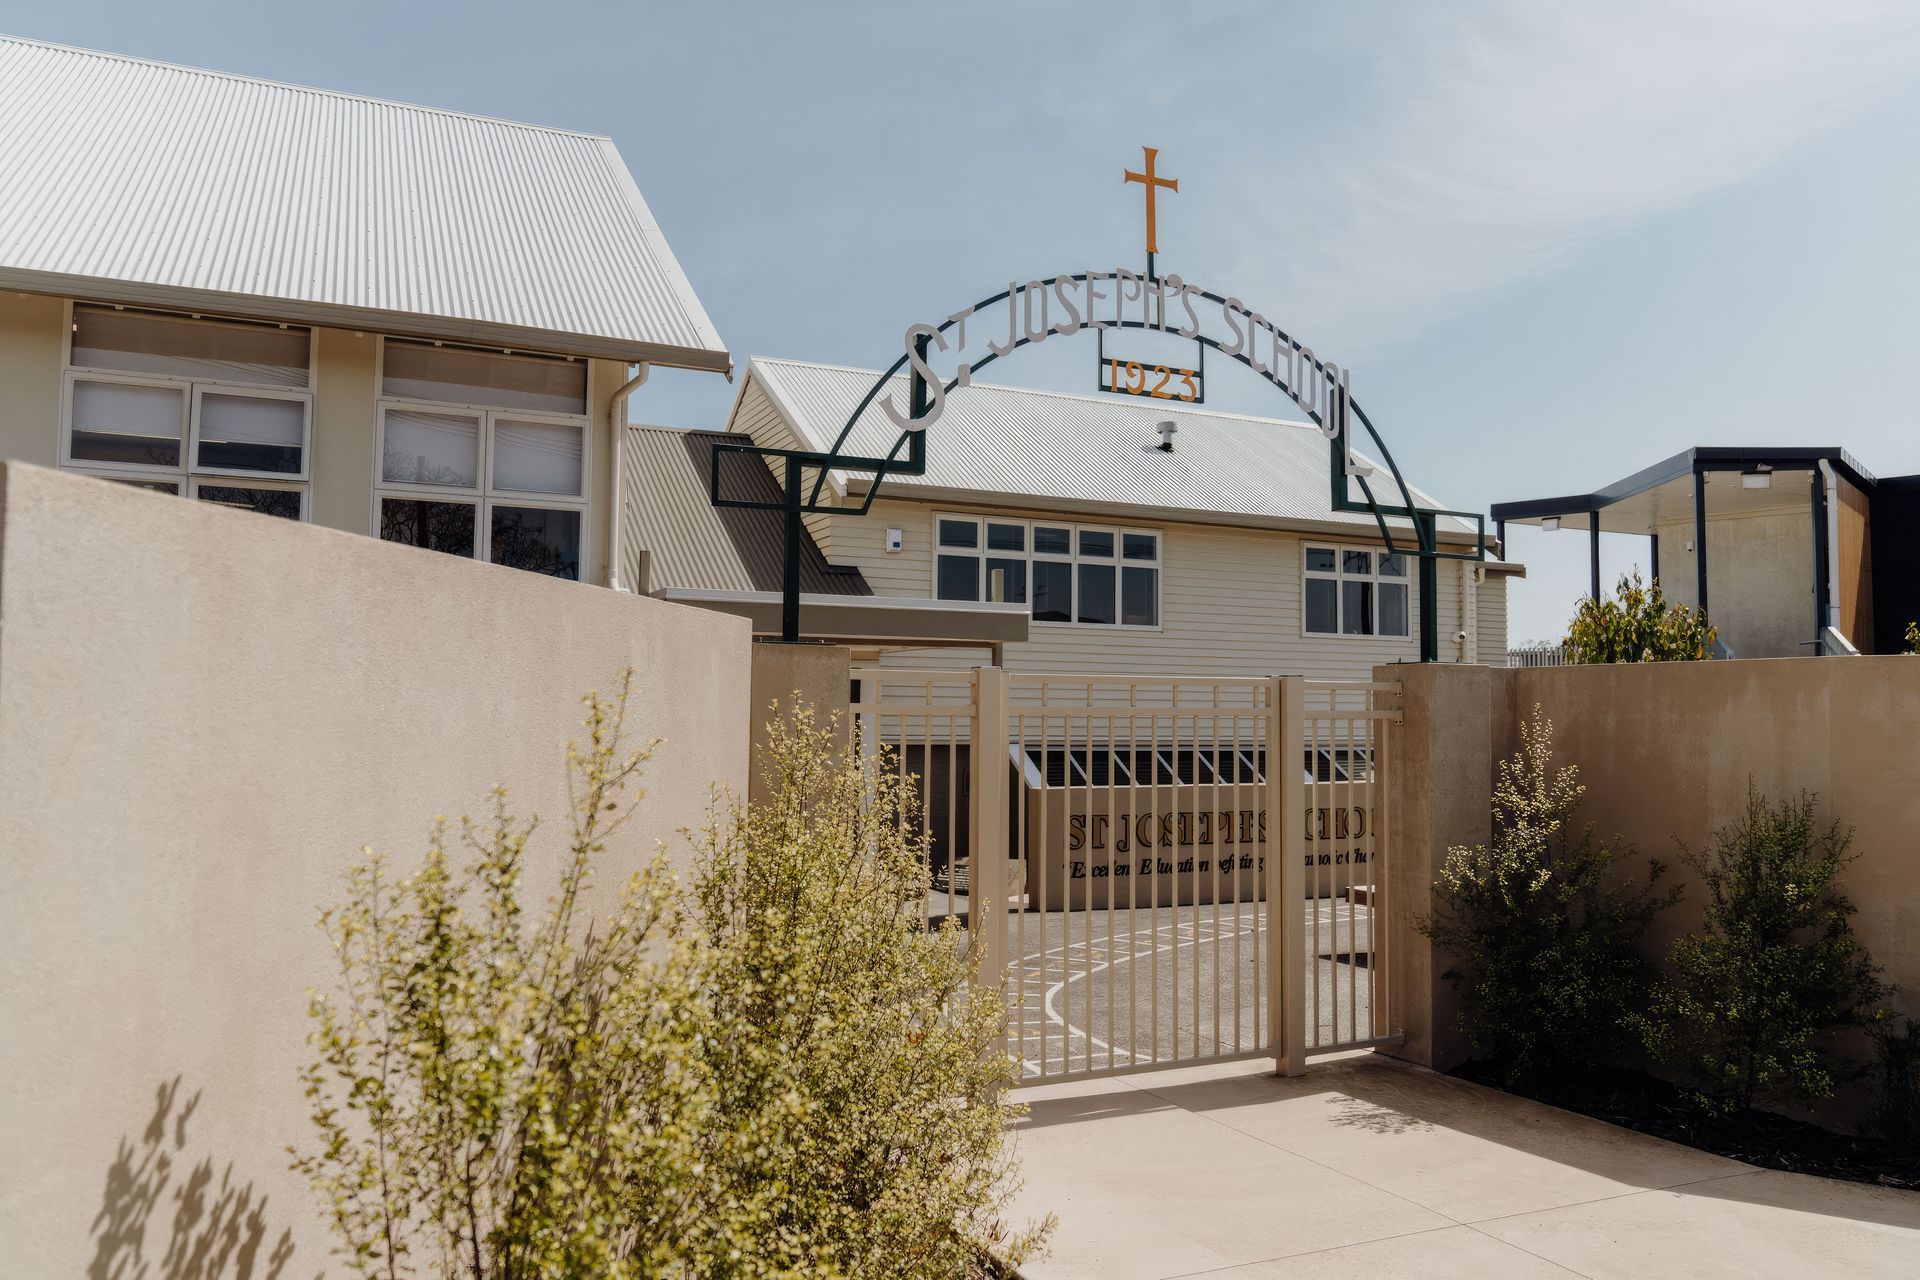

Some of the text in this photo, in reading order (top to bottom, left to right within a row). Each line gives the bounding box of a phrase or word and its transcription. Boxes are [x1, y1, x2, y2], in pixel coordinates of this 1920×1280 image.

[986, 267, 1202, 357] JOSEPH'S
[1217, 297, 1376, 478] SCHOOL
[1110, 358, 1198, 403] 1923
[1067, 814, 1109, 851] ST
